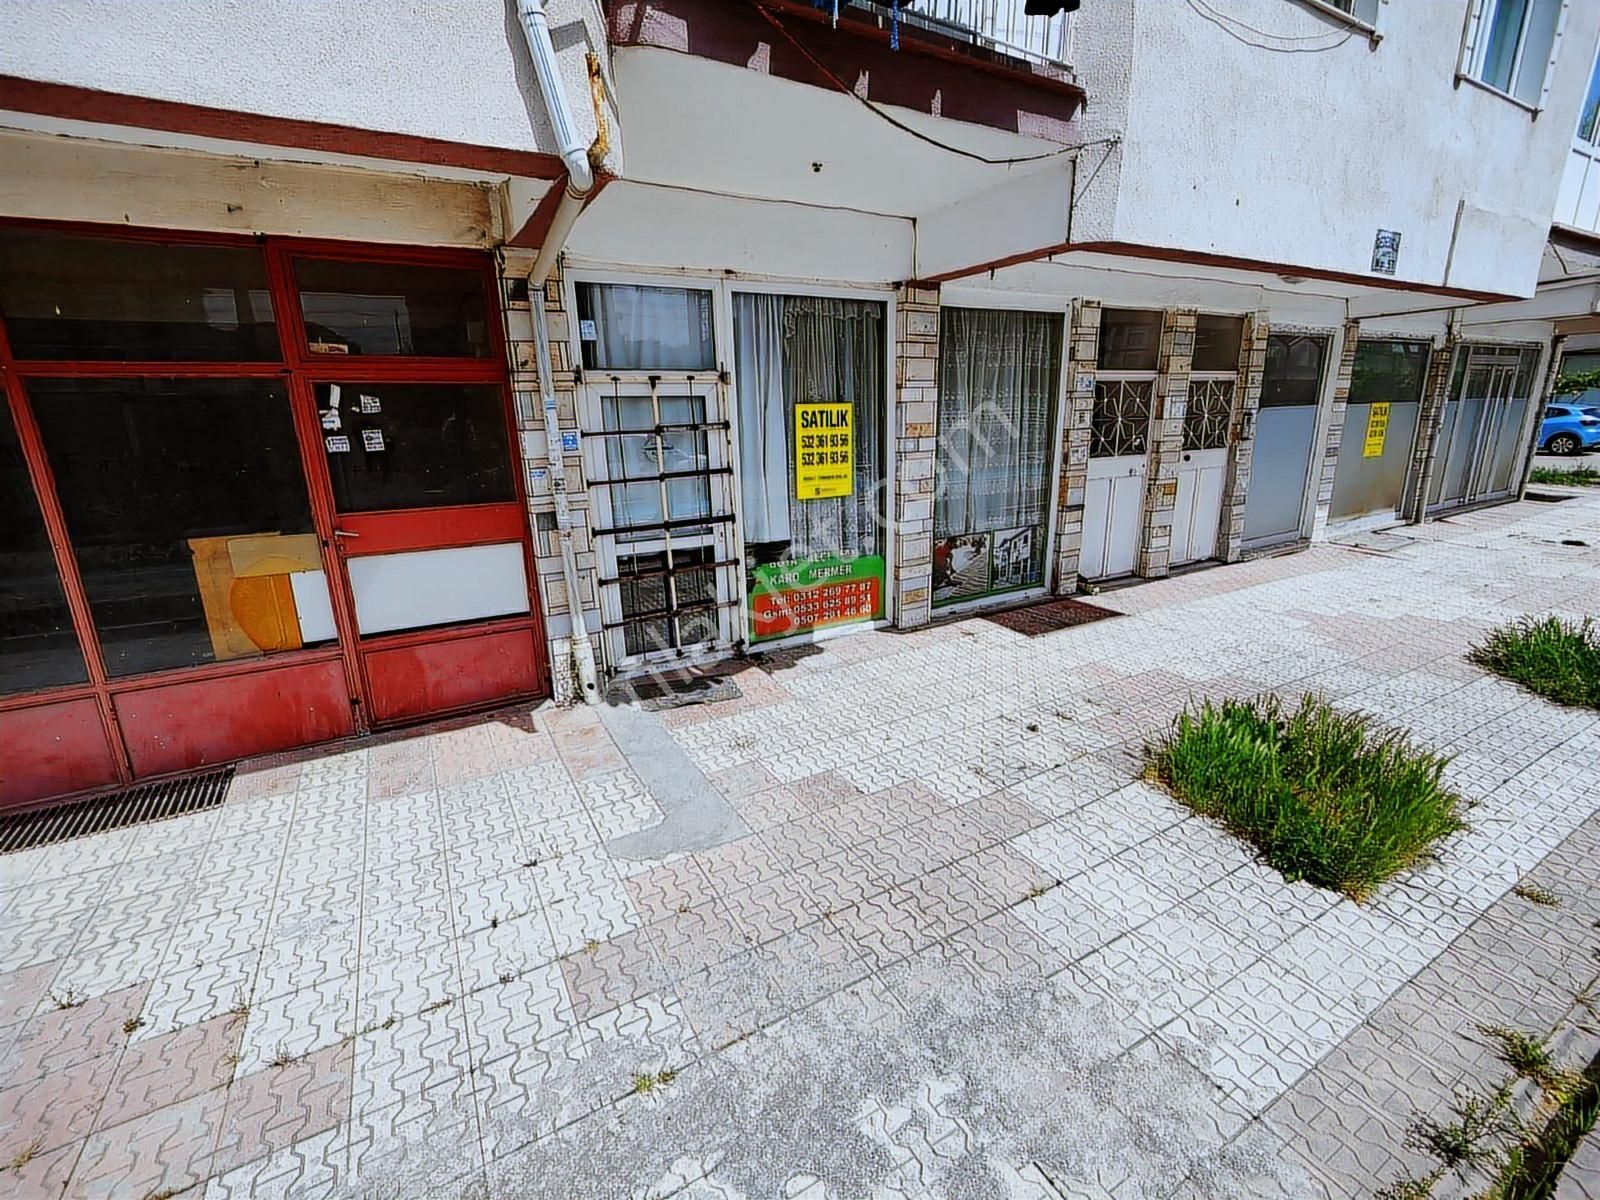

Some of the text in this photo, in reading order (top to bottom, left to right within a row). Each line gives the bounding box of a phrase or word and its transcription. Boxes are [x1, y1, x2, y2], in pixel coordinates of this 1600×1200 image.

[801, 409, 849, 429] SATILIK
[770, 564, 853, 585] KARO MERMER
